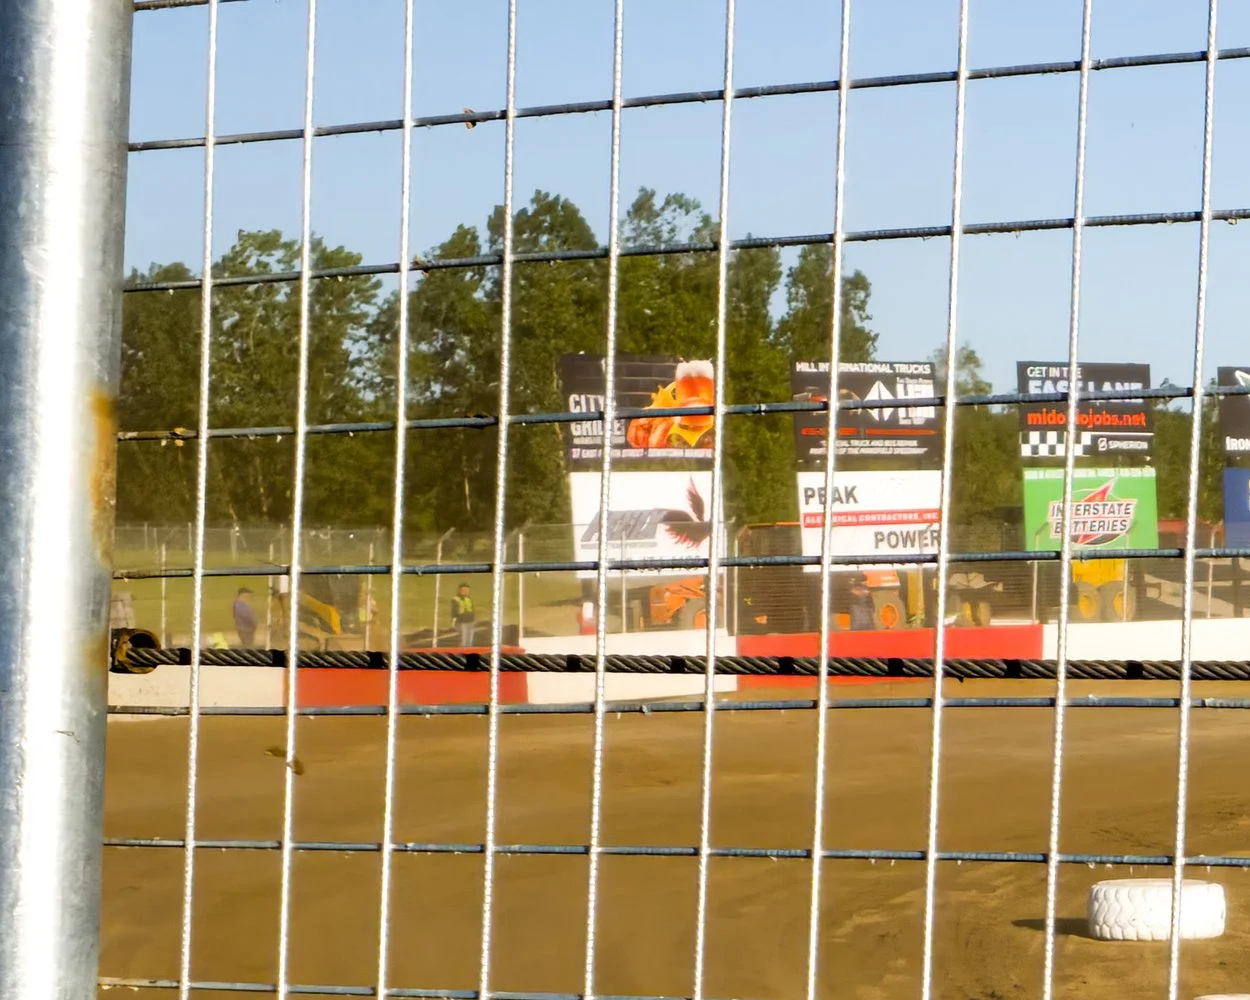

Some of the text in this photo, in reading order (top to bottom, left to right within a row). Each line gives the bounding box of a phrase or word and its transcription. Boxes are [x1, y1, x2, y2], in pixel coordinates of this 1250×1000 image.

[895, 363, 932, 374] TRUCKS
[1027, 366, 1083, 379] GET IN TE
[1027, 408, 1146, 429] midoiojobs.net
[1051, 502, 1133, 518] INERSTATE
[1054, 519, 1128, 534] BTTERIES
[874, 529, 941, 550] POWER
